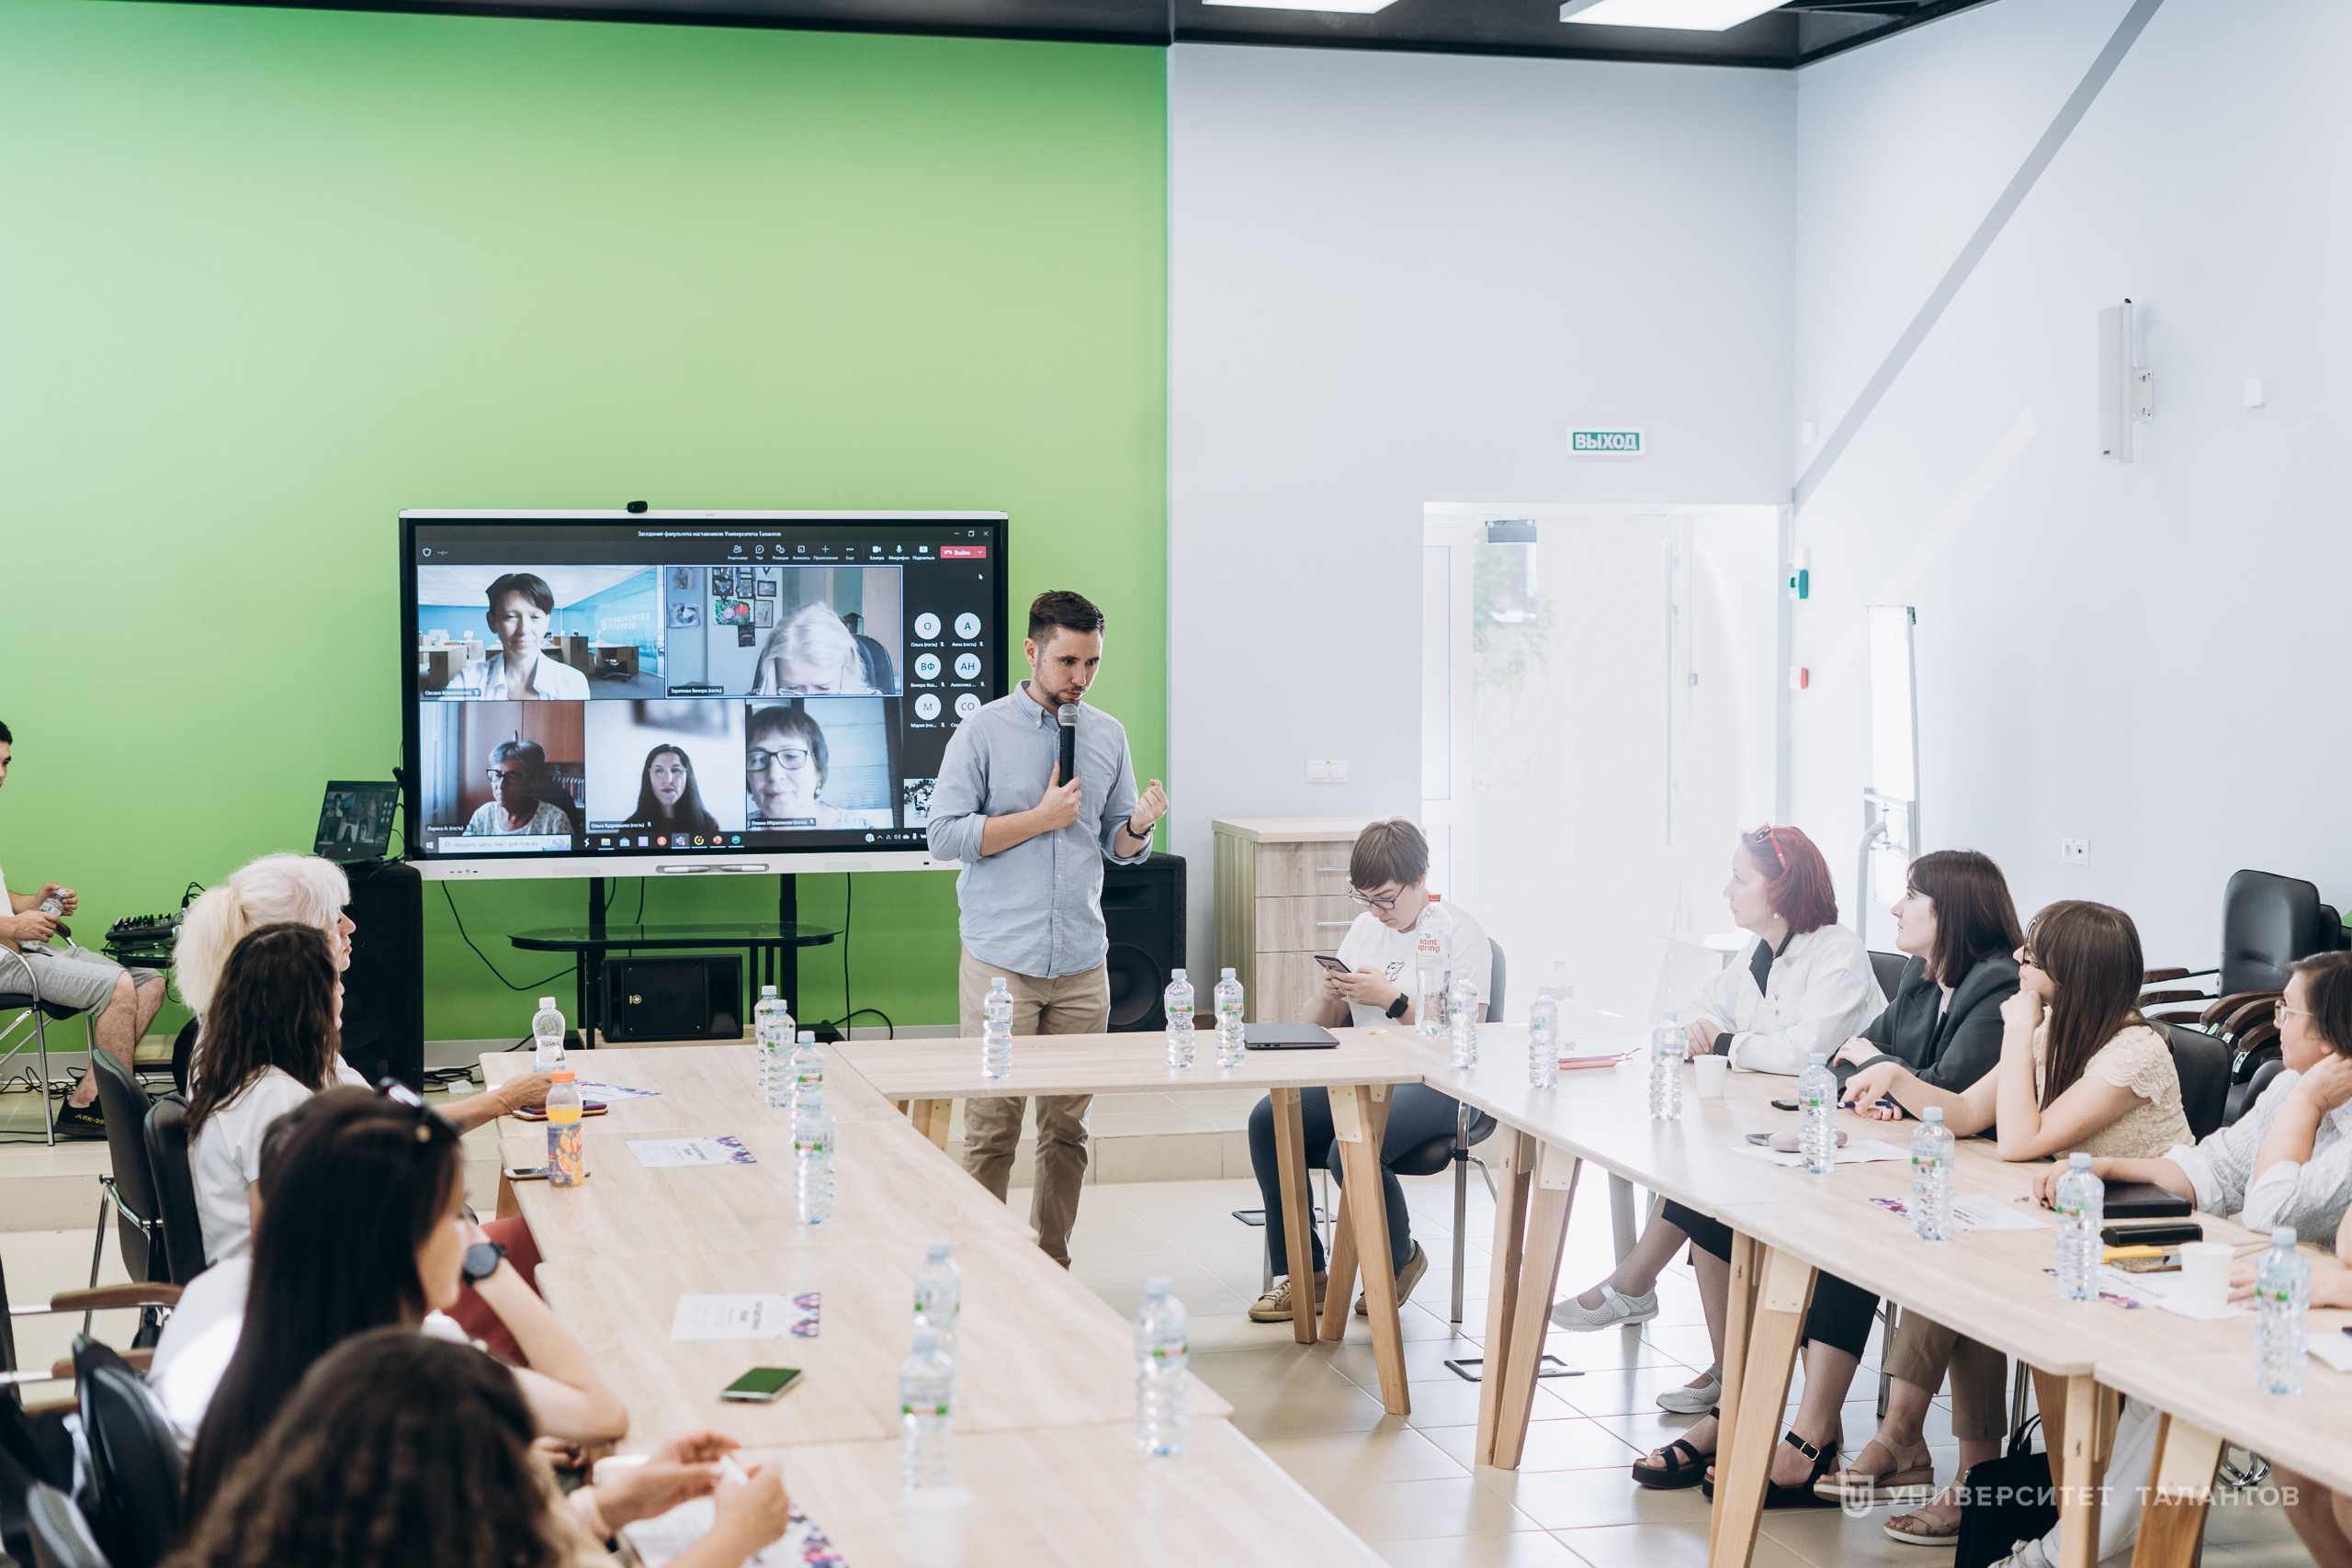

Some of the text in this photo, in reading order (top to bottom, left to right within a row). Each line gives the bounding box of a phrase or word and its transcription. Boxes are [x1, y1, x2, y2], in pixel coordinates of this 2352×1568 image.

[1574, 433, 1637, 450] ВЫХОД
[921, 662, 935, 671] ВФ
[1419, 938, 1438, 946] saint
[1418, 944, 1441, 953] spring
